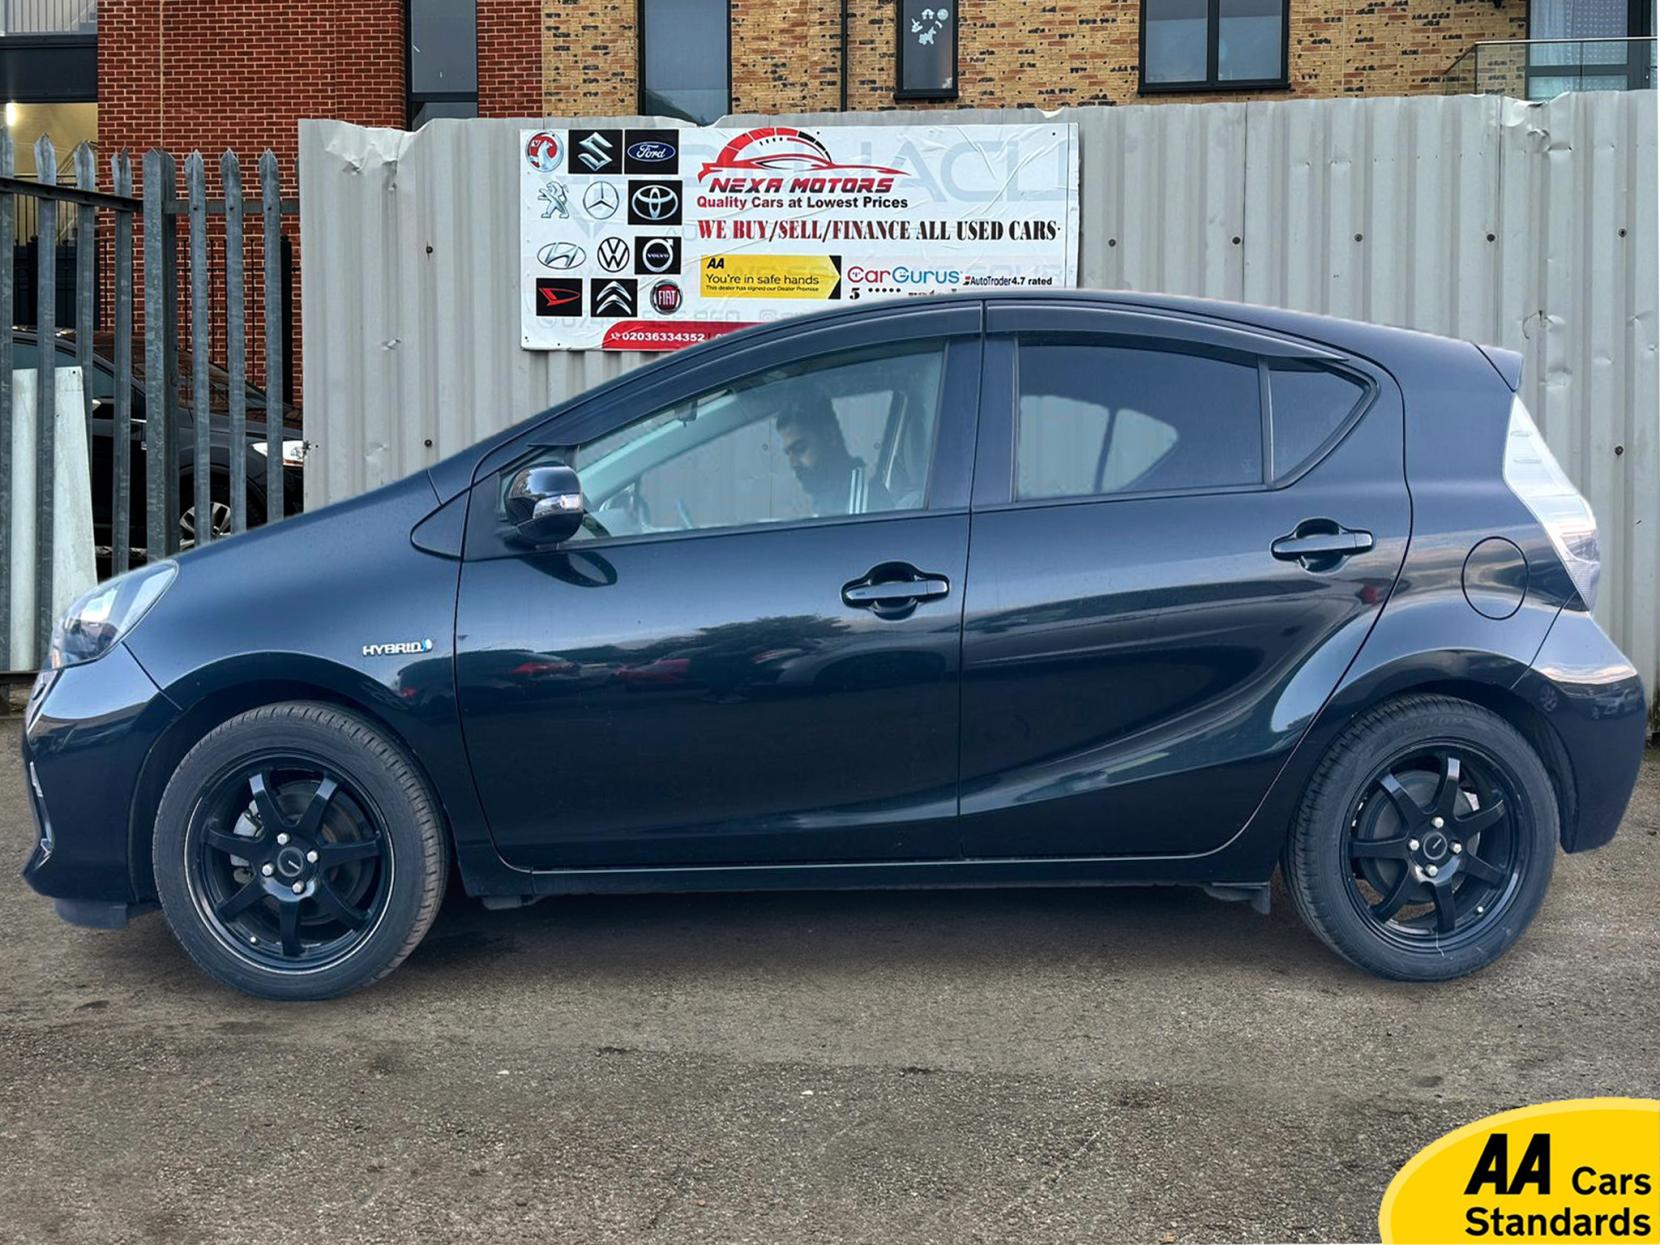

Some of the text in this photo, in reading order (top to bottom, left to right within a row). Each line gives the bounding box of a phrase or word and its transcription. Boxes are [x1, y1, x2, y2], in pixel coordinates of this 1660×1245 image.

[635, 143, 667, 160] Ford
[709, 178, 894, 193] NEXA MOTORS
[697, 196, 908, 210] Quality Cars at Lowest Prices
[698, 220, 727, 240] WE
[916, 220, 951, 241] ALL
[957, 220, 1004, 241] USED
[1009, 220, 1057, 241] CARS
[707, 258, 724, 269] AA
[706, 274, 819, 285] You're in safe hands
[847, 266, 960, 284] CarGurus
[1028, 277, 1053, 286] rated
[658, 290, 676, 305] FIAT
[622, 332, 705, 342] 02036334352
[362, 642, 422, 656] HYBRID
